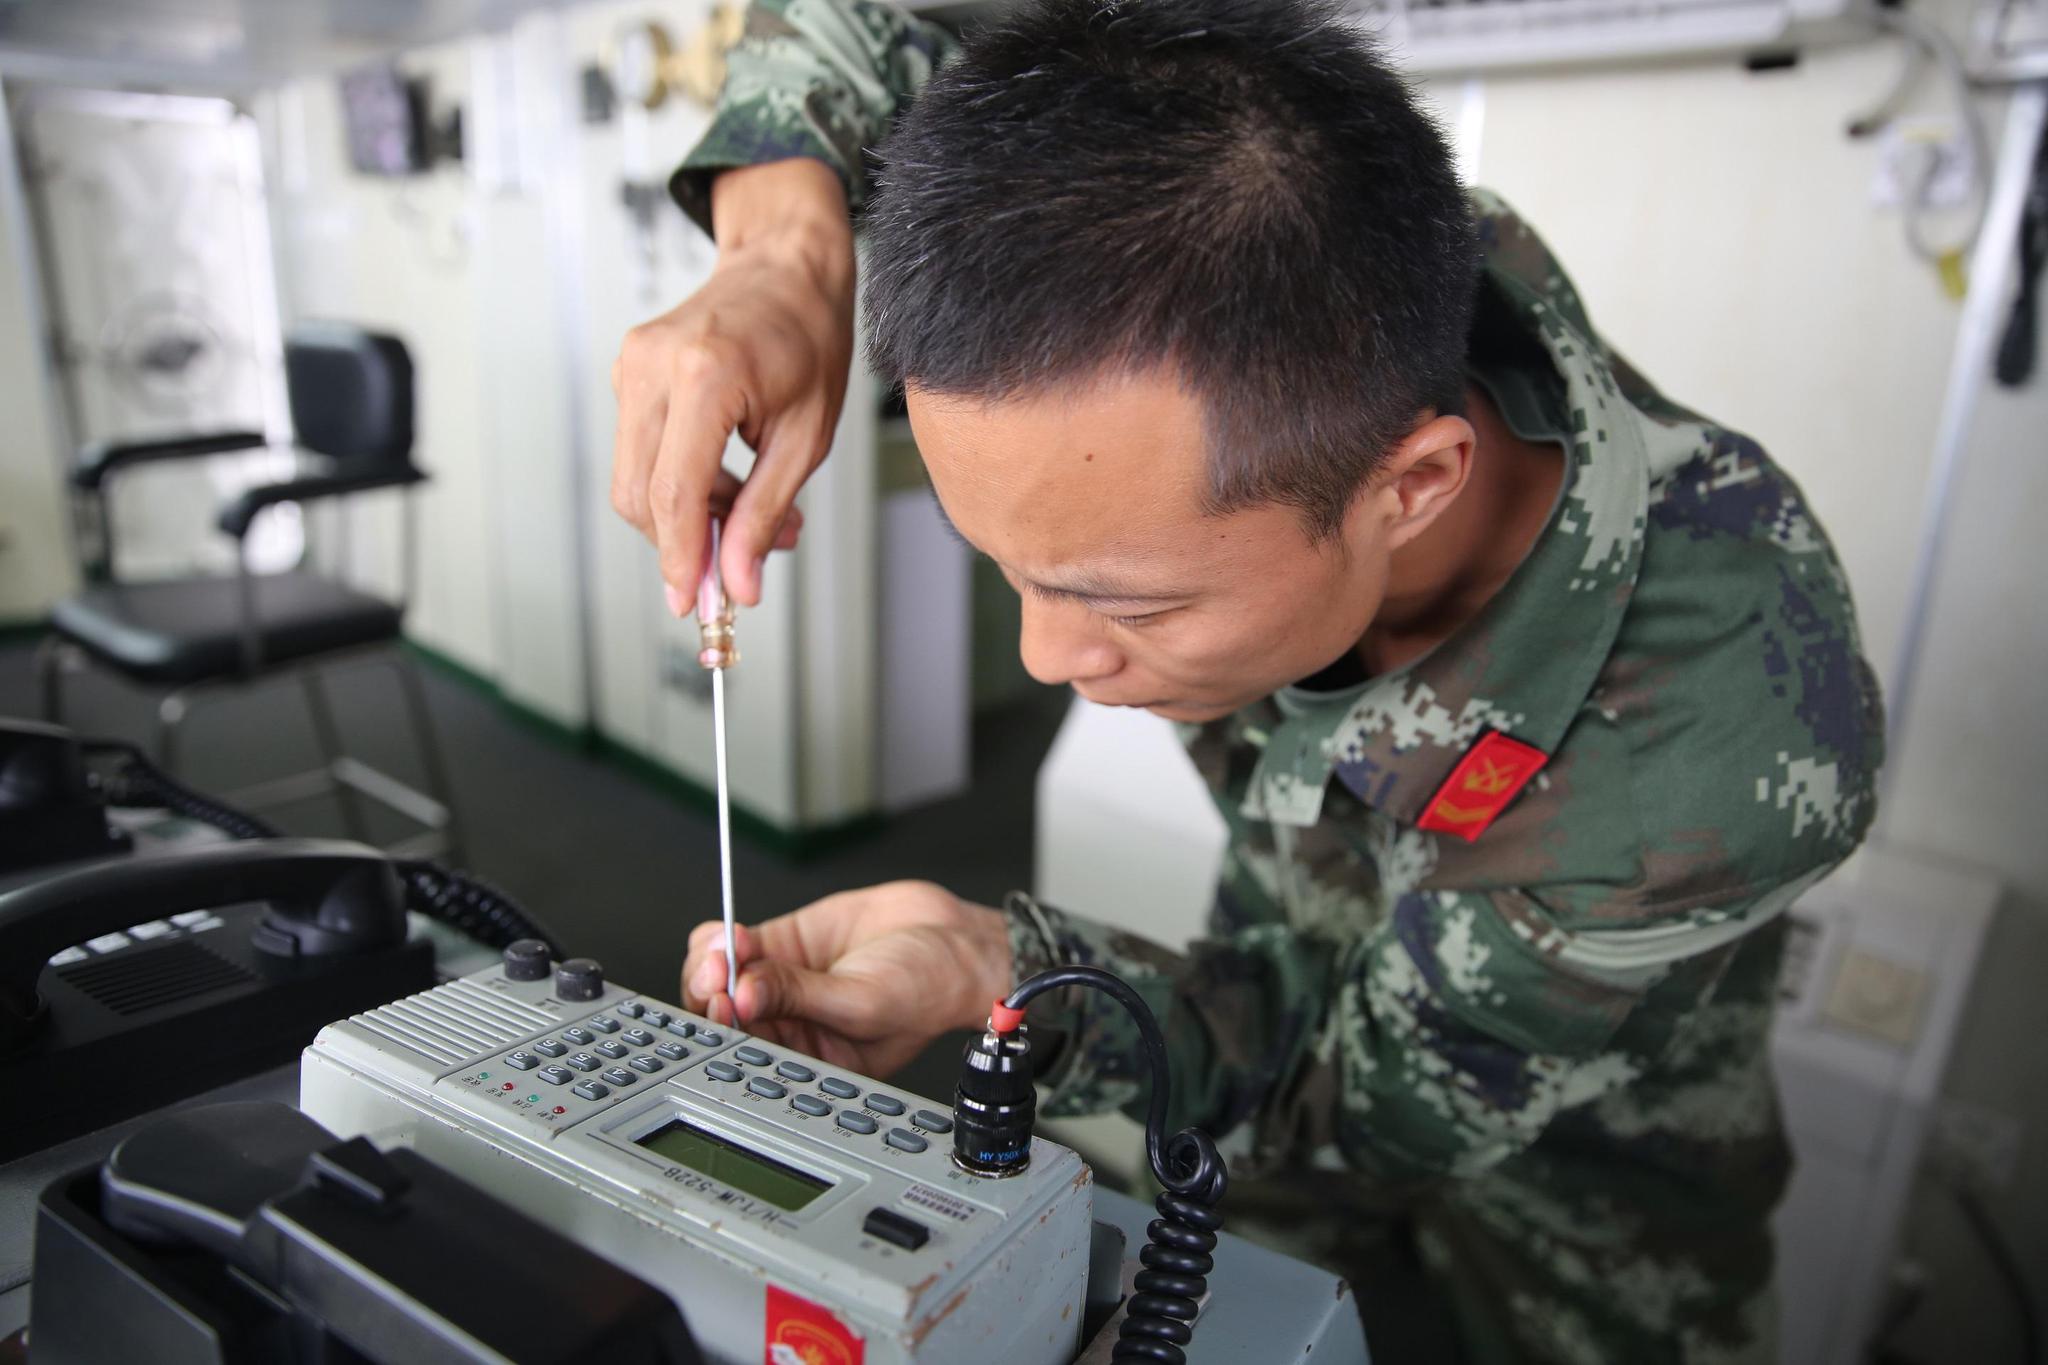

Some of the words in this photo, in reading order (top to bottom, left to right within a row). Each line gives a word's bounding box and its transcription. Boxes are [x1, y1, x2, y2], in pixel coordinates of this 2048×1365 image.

[542, 1039, 557, 1047] 6
[604, 1041, 618, 1049] 8
[513, 1051, 528, 1060] 3
[575, 1053, 591, 1062] 5
[638, 1055, 652, 1064] 7
[547, 1064, 565, 1074] 2
[612, 1067, 627, 1075] 4
[584, 1079, 596, 1089] 1
[911, 1126, 928, 1136] 16
[980, 1151, 994, 1161] HY
